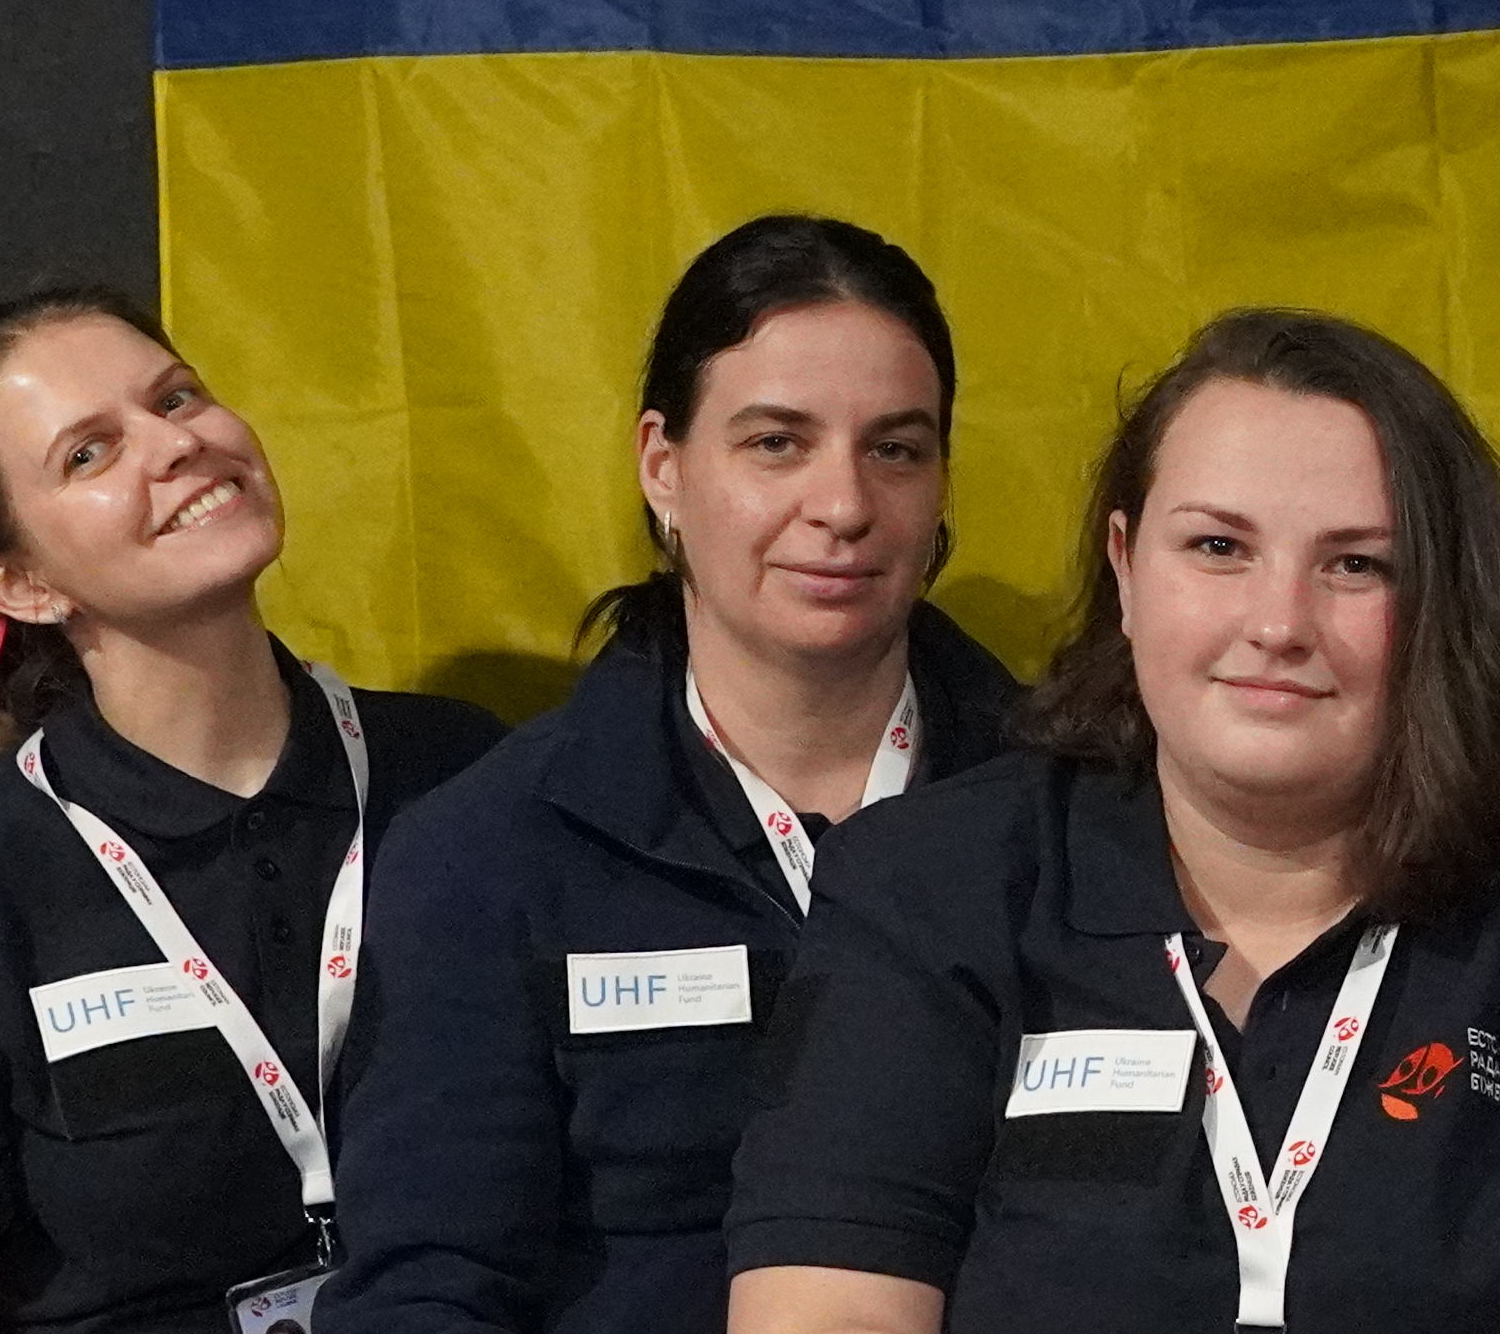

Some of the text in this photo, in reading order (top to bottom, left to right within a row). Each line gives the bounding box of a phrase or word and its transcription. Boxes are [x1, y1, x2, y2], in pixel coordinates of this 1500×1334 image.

[677, 973, 713, 982] Ukraine
[581, 975, 667, 1007] UHF
[678, 982, 740, 992] Humanitarian
[679, 995, 702, 1004] Fund
[48, 988, 135, 1033] UHF
[1115, 1057, 1151, 1066] Ukraine
[1023, 1056, 1104, 1091] UHF
[1112, 1069, 1176, 1079] Humanitarian
[1110, 1080, 1134, 1089] Fund
